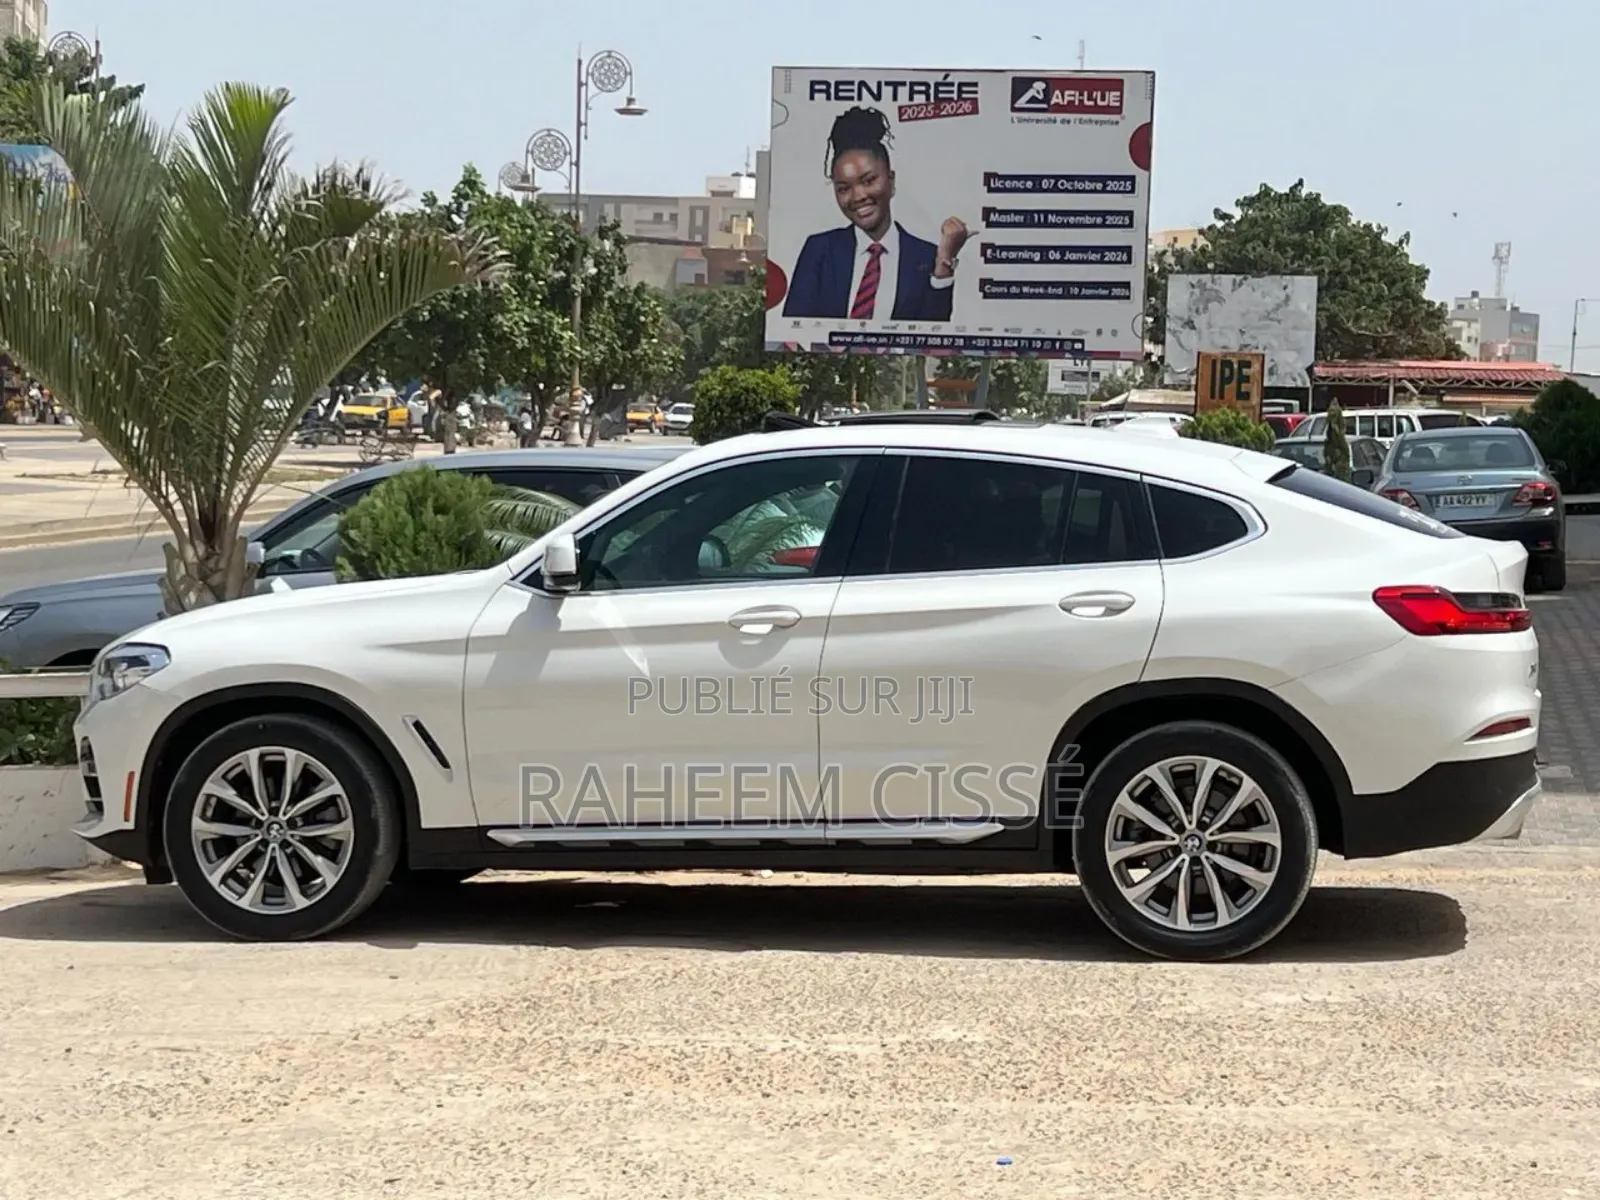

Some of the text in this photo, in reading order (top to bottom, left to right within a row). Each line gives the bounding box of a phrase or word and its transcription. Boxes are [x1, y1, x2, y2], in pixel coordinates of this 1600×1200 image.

[809, 73, 979, 102] RENTRÉE
[1050, 89, 1121, 107] AFI-L'UE
[900, 101, 973, 120] 2025-2026
[1011, 115, 1057, 125] L'Université
[1060, 117, 1071, 125] de
[990, 177, 1033, 189] Licence
[1041, 178, 1055, 189] 07
[1057, 178, 1104, 191] Octobre
[1105, 180, 1132, 191] 2025
[989, 212, 1025, 223] Master
[1033, 213, 1045, 223] 11
[1047, 213, 1103, 225] Novembre
[1105, 214, 1130, 225] 2025
[986, 248, 1041, 261] E-Learning
[1048, 249, 1061, 260] 06
[1063, 250, 1101, 261] Janvier
[1103, 251, 1128, 262] 2026
[984, 284, 1008, 293] Cours
[1022, 285, 1063, 295] Week-End
[1080, 286, 1110, 296] Janvier
[1209, 358, 1253, 401] IPE
